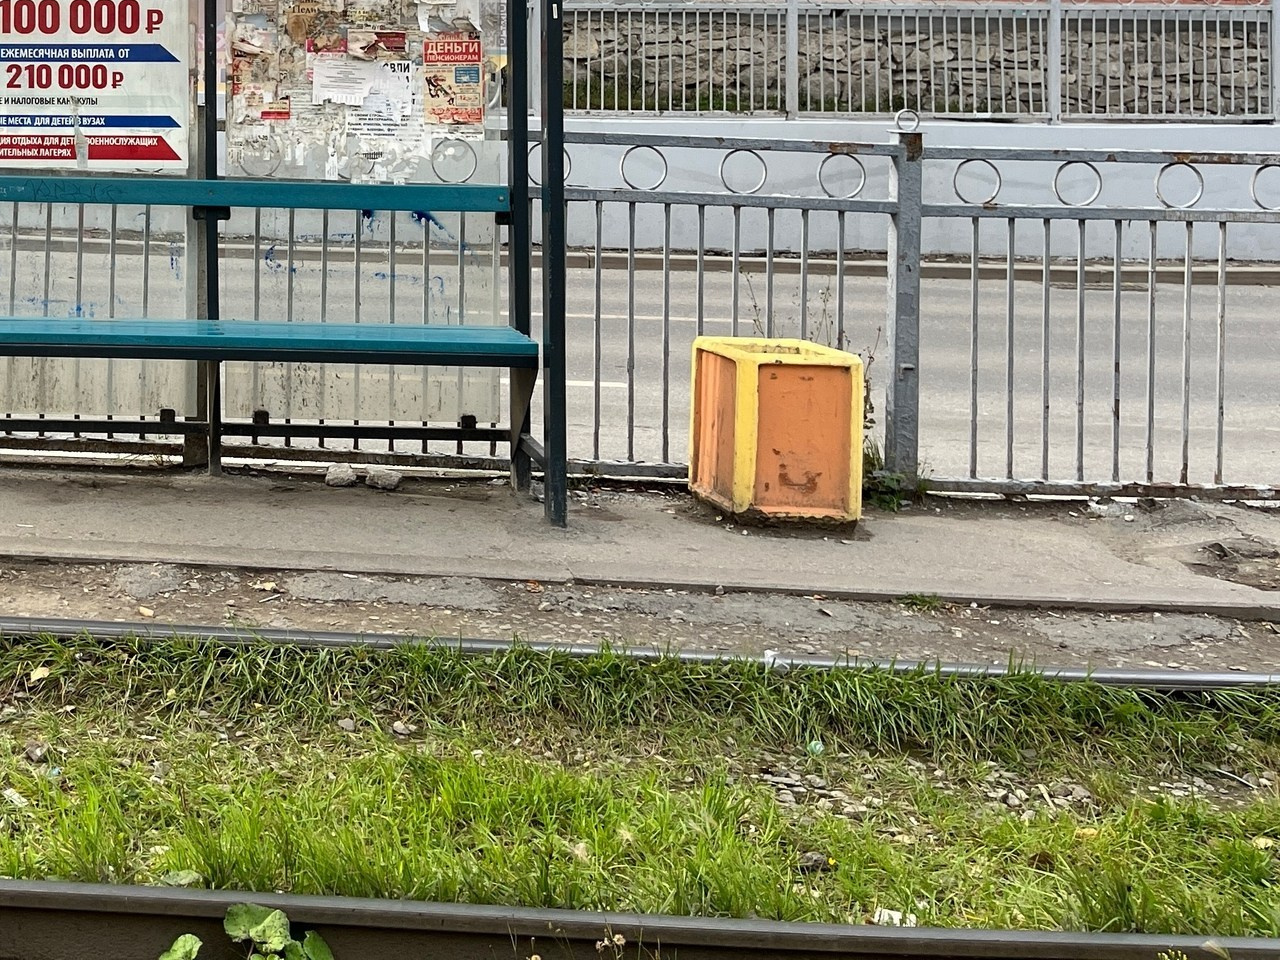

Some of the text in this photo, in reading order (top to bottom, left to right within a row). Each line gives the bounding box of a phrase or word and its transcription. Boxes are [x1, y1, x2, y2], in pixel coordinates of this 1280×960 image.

[145, 9, 164, 34] ₽
[0, 48, 130, 59] ЕЖЕМЕСЯЧНАЯ ВЫПЛАТА ОТ
[427, 42, 479, 55] ДЕНЬГИ
[6, 64, 124, 89] 210 000 ₽
[4, 97, 10, 105] И
[10, 97, 56, 105] НАЛОГОВЫЕ
[8, 117, 32, 125] МЕСТА
[34, 117, 50, 126] ДЛЯ
[50, 115, 74, 126] ДЕТЕЙ
[82, 117, 105, 126] ВУЗАХ
[12, 137, 42, 146] ОТДЫХА
[43, 137, 59, 146] ДЛЯ
[60, 137, 77, 146] ДЕТ
[39, 148, 72, 156] ЛАГЕРЯХ
